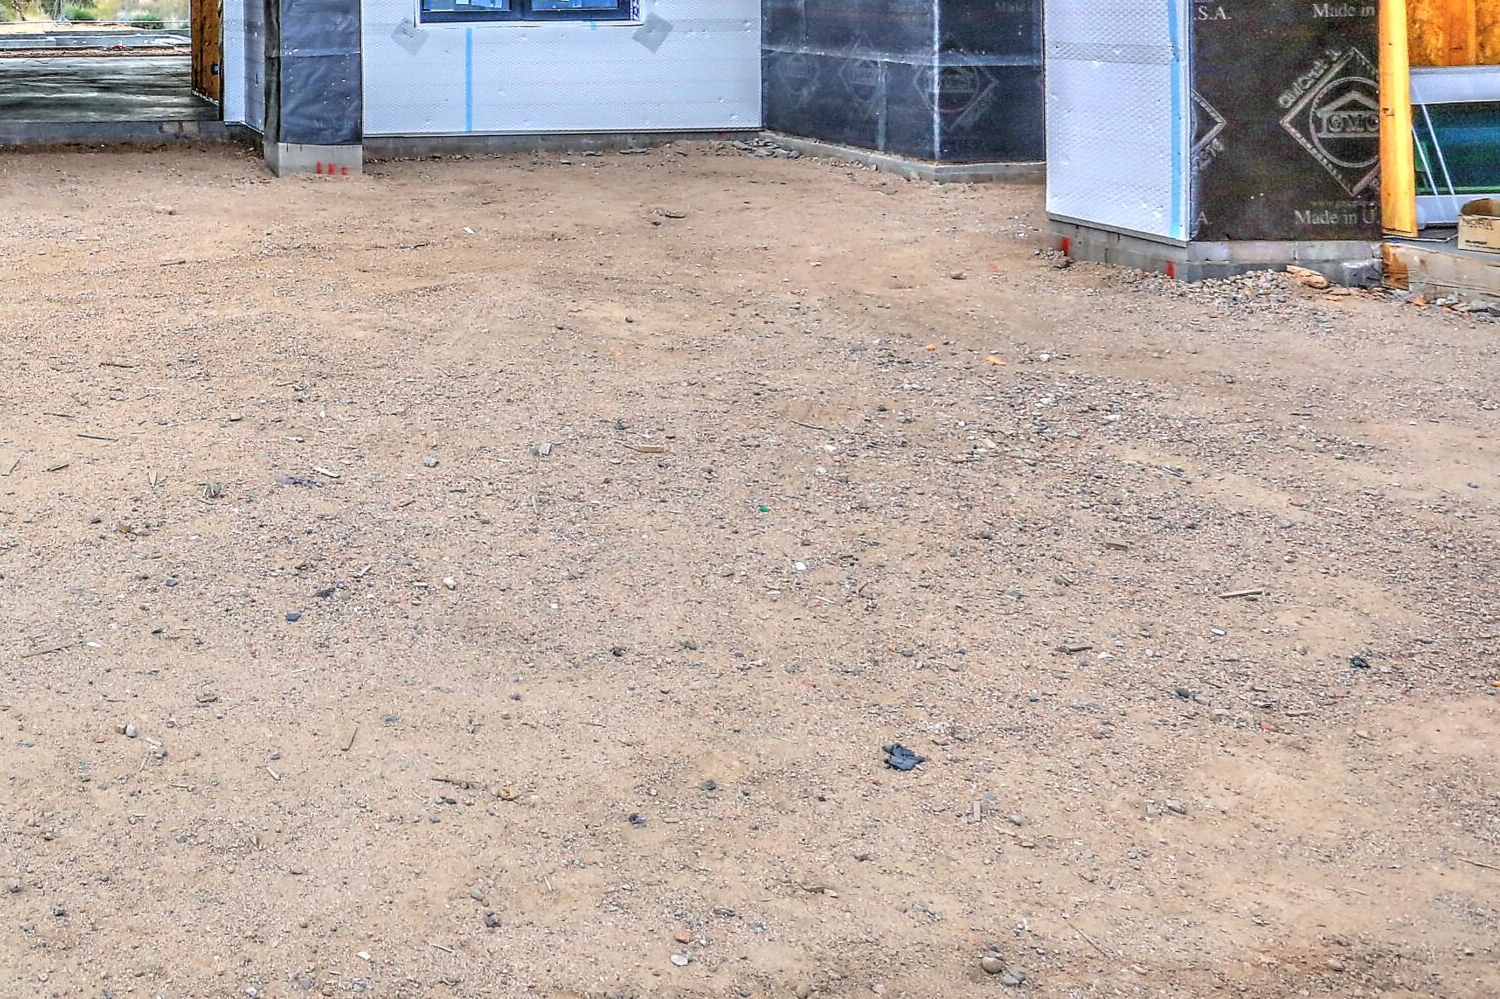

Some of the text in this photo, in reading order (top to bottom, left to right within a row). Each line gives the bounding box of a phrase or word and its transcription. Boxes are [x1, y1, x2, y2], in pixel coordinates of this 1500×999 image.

[1192, 6, 1232, 20] .S.A.
[1312, 3, 1376, 18] Made in
[1293, 210, 1338, 225] Made
[1341, 210, 1357, 224] in
